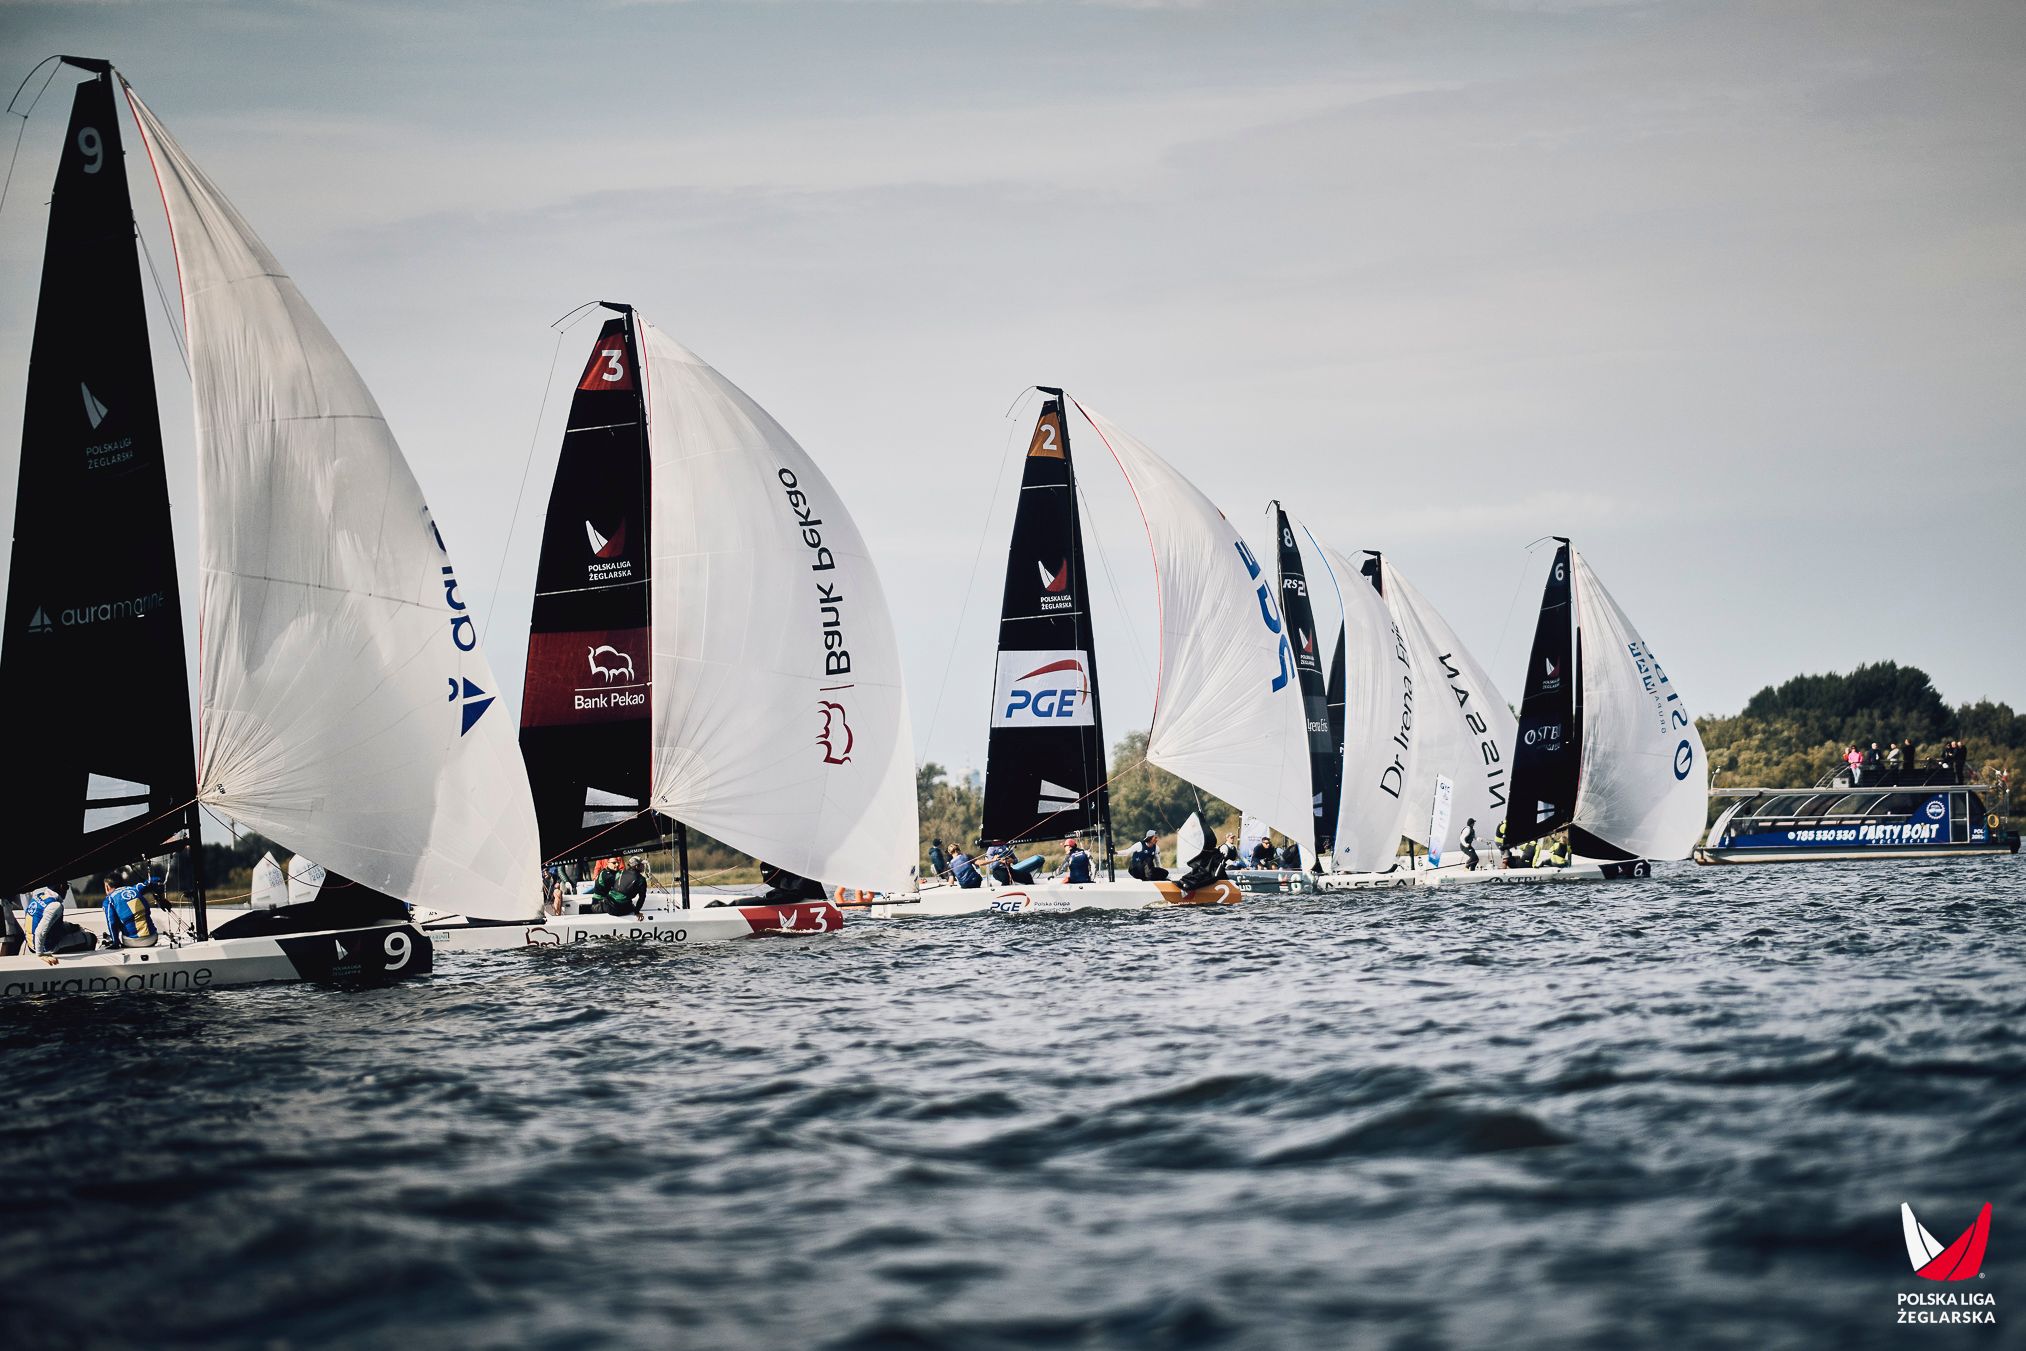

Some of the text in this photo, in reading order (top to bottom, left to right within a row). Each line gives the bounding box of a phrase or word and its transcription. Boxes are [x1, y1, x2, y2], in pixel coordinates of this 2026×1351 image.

[77, 127, 103, 174] 9
[601, 349, 624, 382] 3
[1040, 424, 1057, 450] 2
[1283, 527, 1293, 548] 8
[588, 560, 631, 572] POLSKA LIGA
[589, 569, 632, 581] ŻEGLARSKA
[1555, 562, 1565, 581] 6
[574, 691, 645, 710] Bank Pekao
[1005, 689, 1077, 718] PGE
[1392, 675, 1414, 752] Irena
[1379, 753, 1406, 800] Dr
[1859, 822, 1939, 840] PARTY BOAT
[1633, 862, 1644, 877] 6
[989, 902, 1022, 912] PGE
[809, 906, 828, 932] 3
[629, 926, 687, 942] Pekao
[383, 931, 412, 971] 9
[4, 967, 213, 996] auramarine
